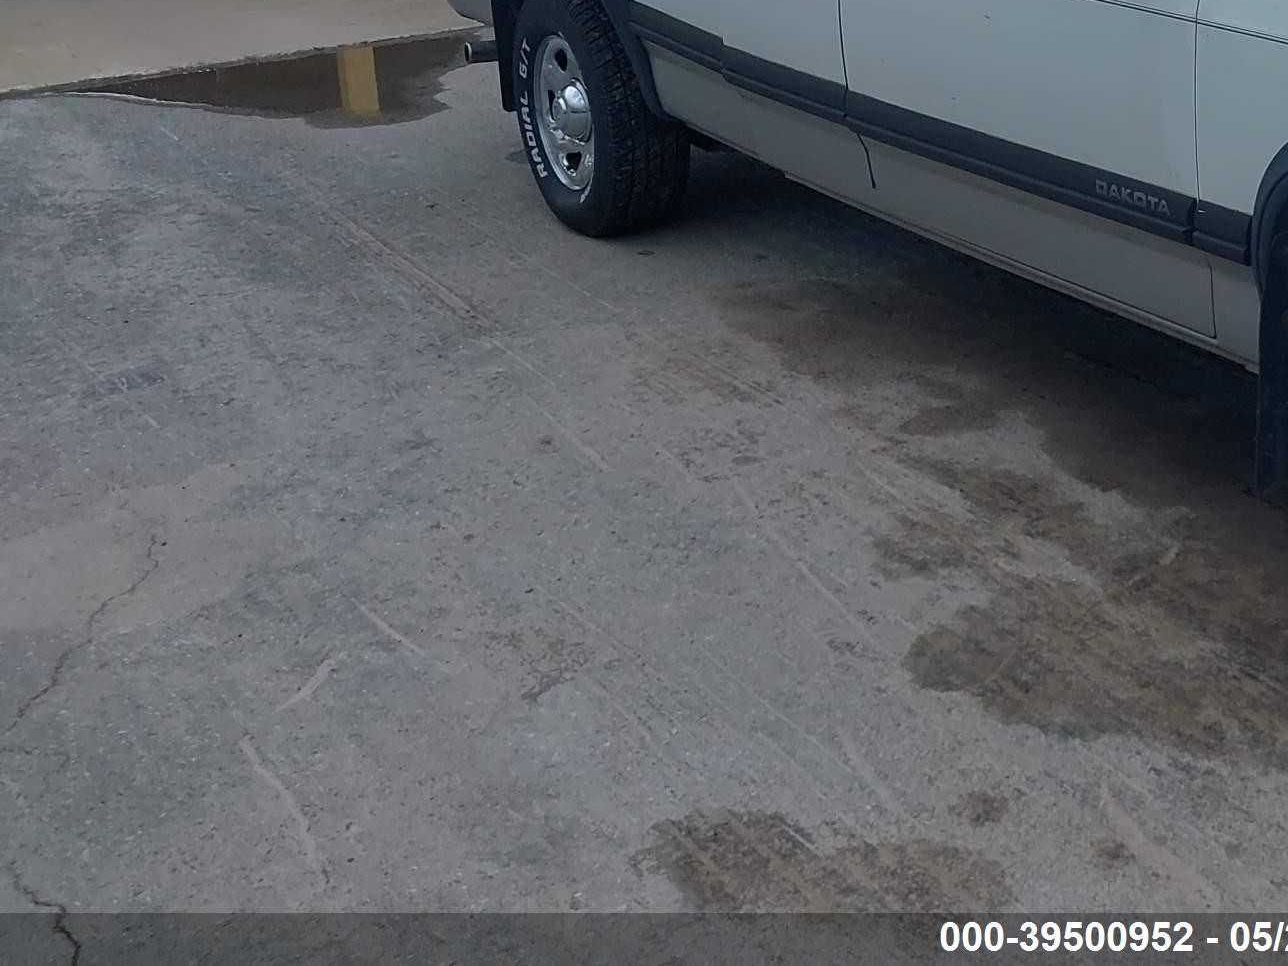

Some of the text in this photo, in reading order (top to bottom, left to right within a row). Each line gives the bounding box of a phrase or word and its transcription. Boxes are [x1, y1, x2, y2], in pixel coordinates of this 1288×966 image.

[517, 38, 548, 178] RADIAL G/T
[1095, 179, 1170, 216] DAKOTA
